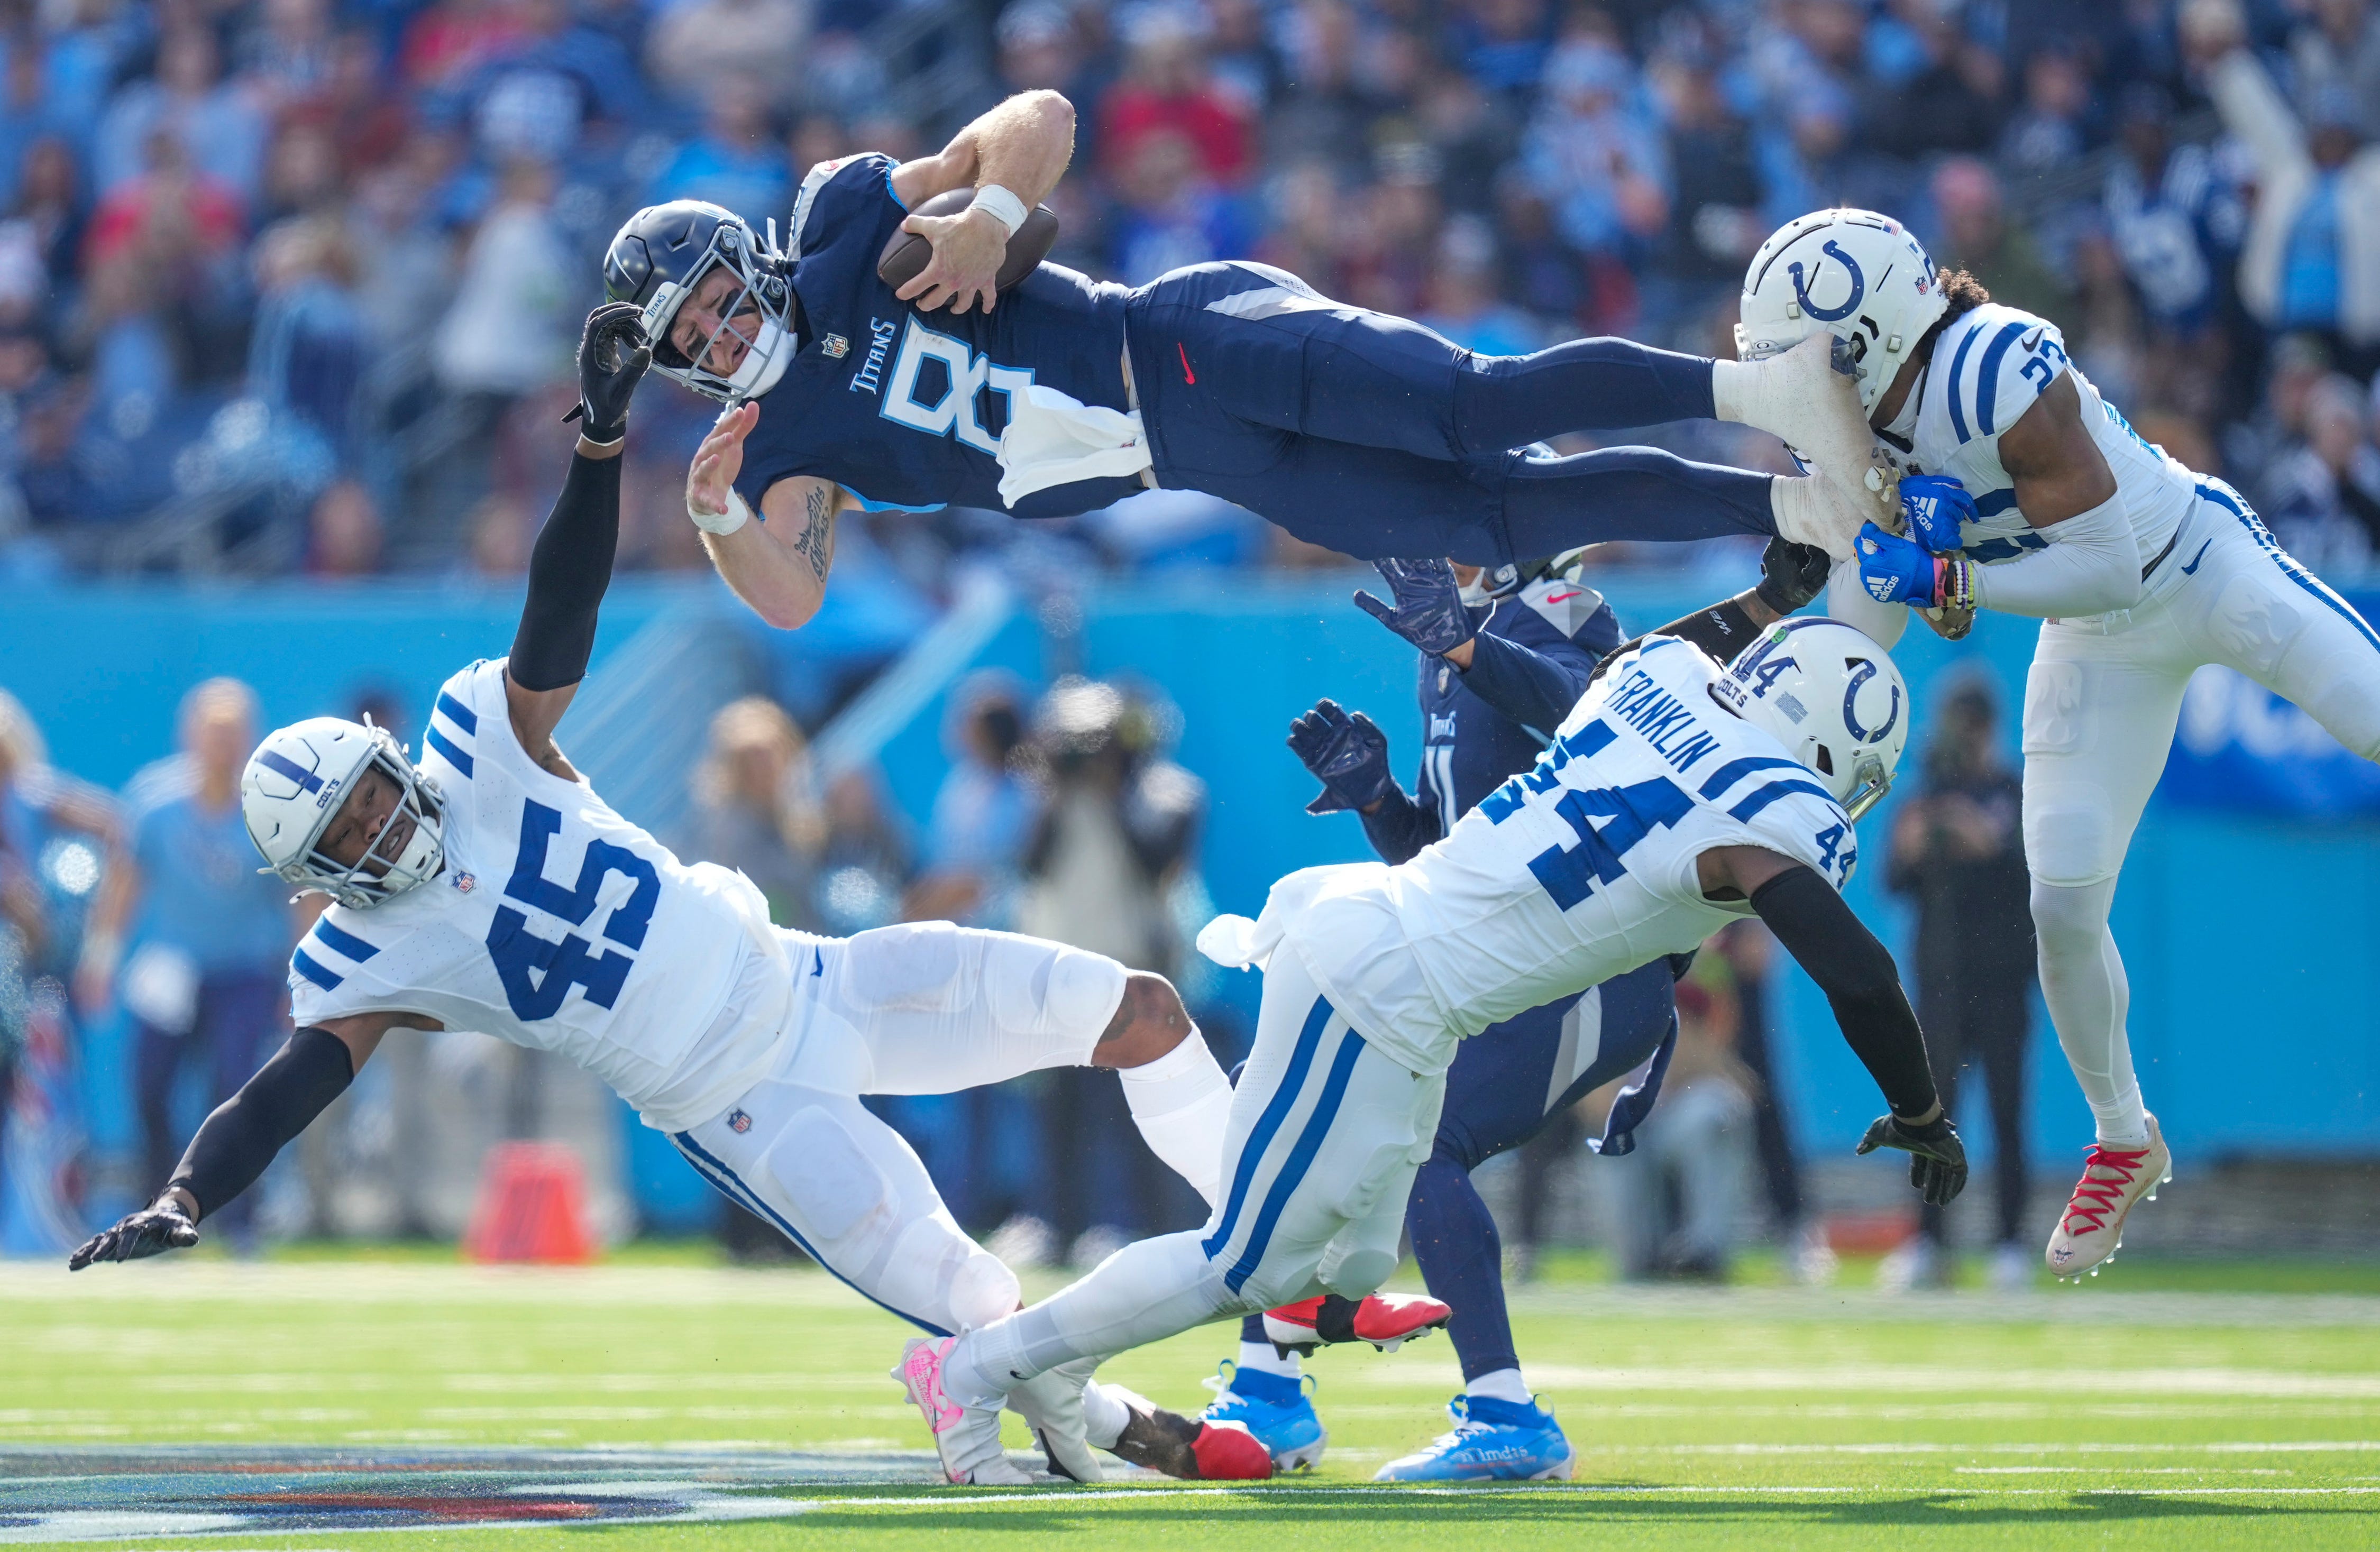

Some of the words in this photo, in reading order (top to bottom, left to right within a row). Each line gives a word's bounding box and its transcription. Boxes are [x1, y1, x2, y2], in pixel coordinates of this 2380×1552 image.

[645, 292, 666, 318] TITANS
[848, 317, 896, 395] TITANS
[878, 311, 1036, 457] 8
[1879, 575, 1899, 602] adidas
[1603, 669, 1721, 774] FRANKLIN
[1717, 678, 1748, 708] COLTS
[316, 778, 341, 809] COLTS
[1815, 822, 1857, 891] 44
[485, 796, 661, 1022] 45
